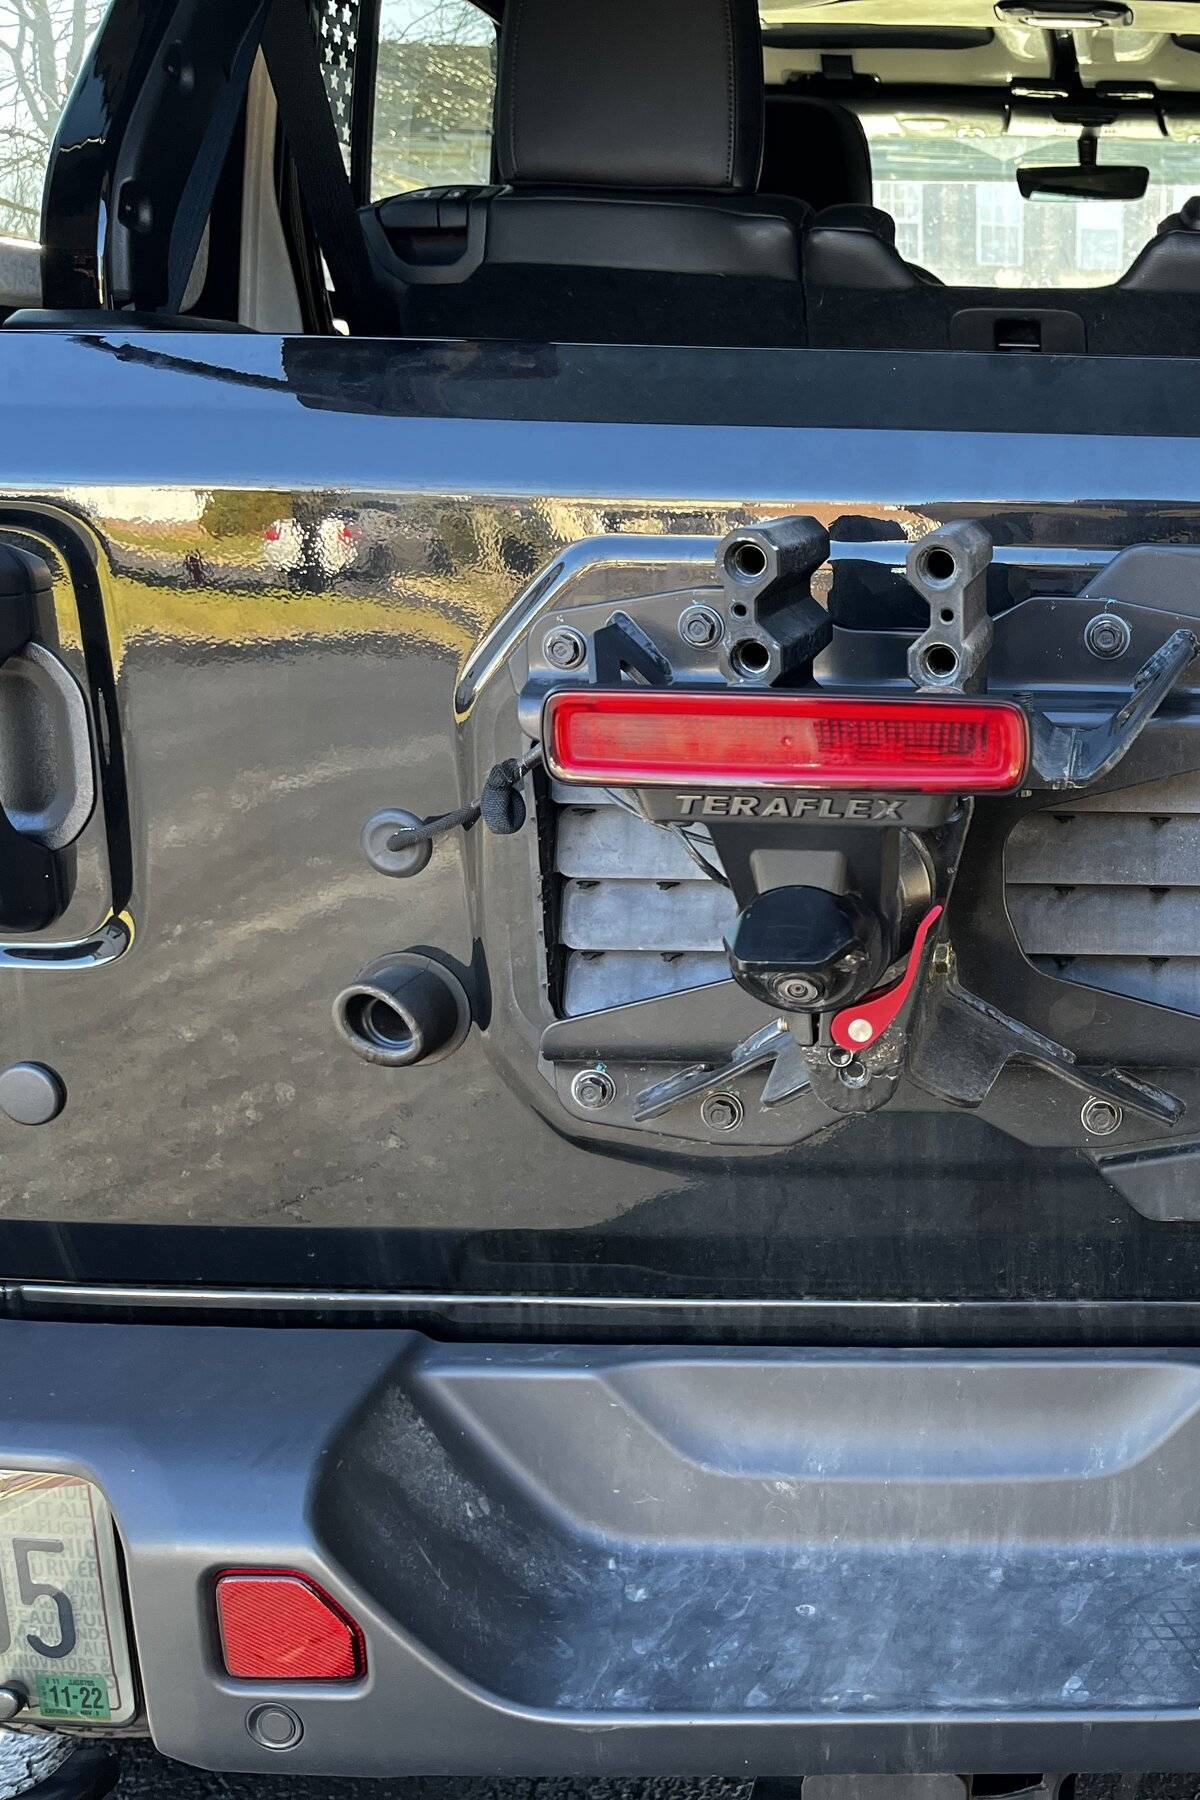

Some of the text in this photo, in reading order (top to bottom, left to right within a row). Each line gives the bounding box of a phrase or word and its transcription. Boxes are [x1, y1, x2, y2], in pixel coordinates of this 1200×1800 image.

[675, 794, 905, 820] TERAFLEX
[0, 1537, 76, 1658] 5
[49, 1685, 104, 1709] 11-22
